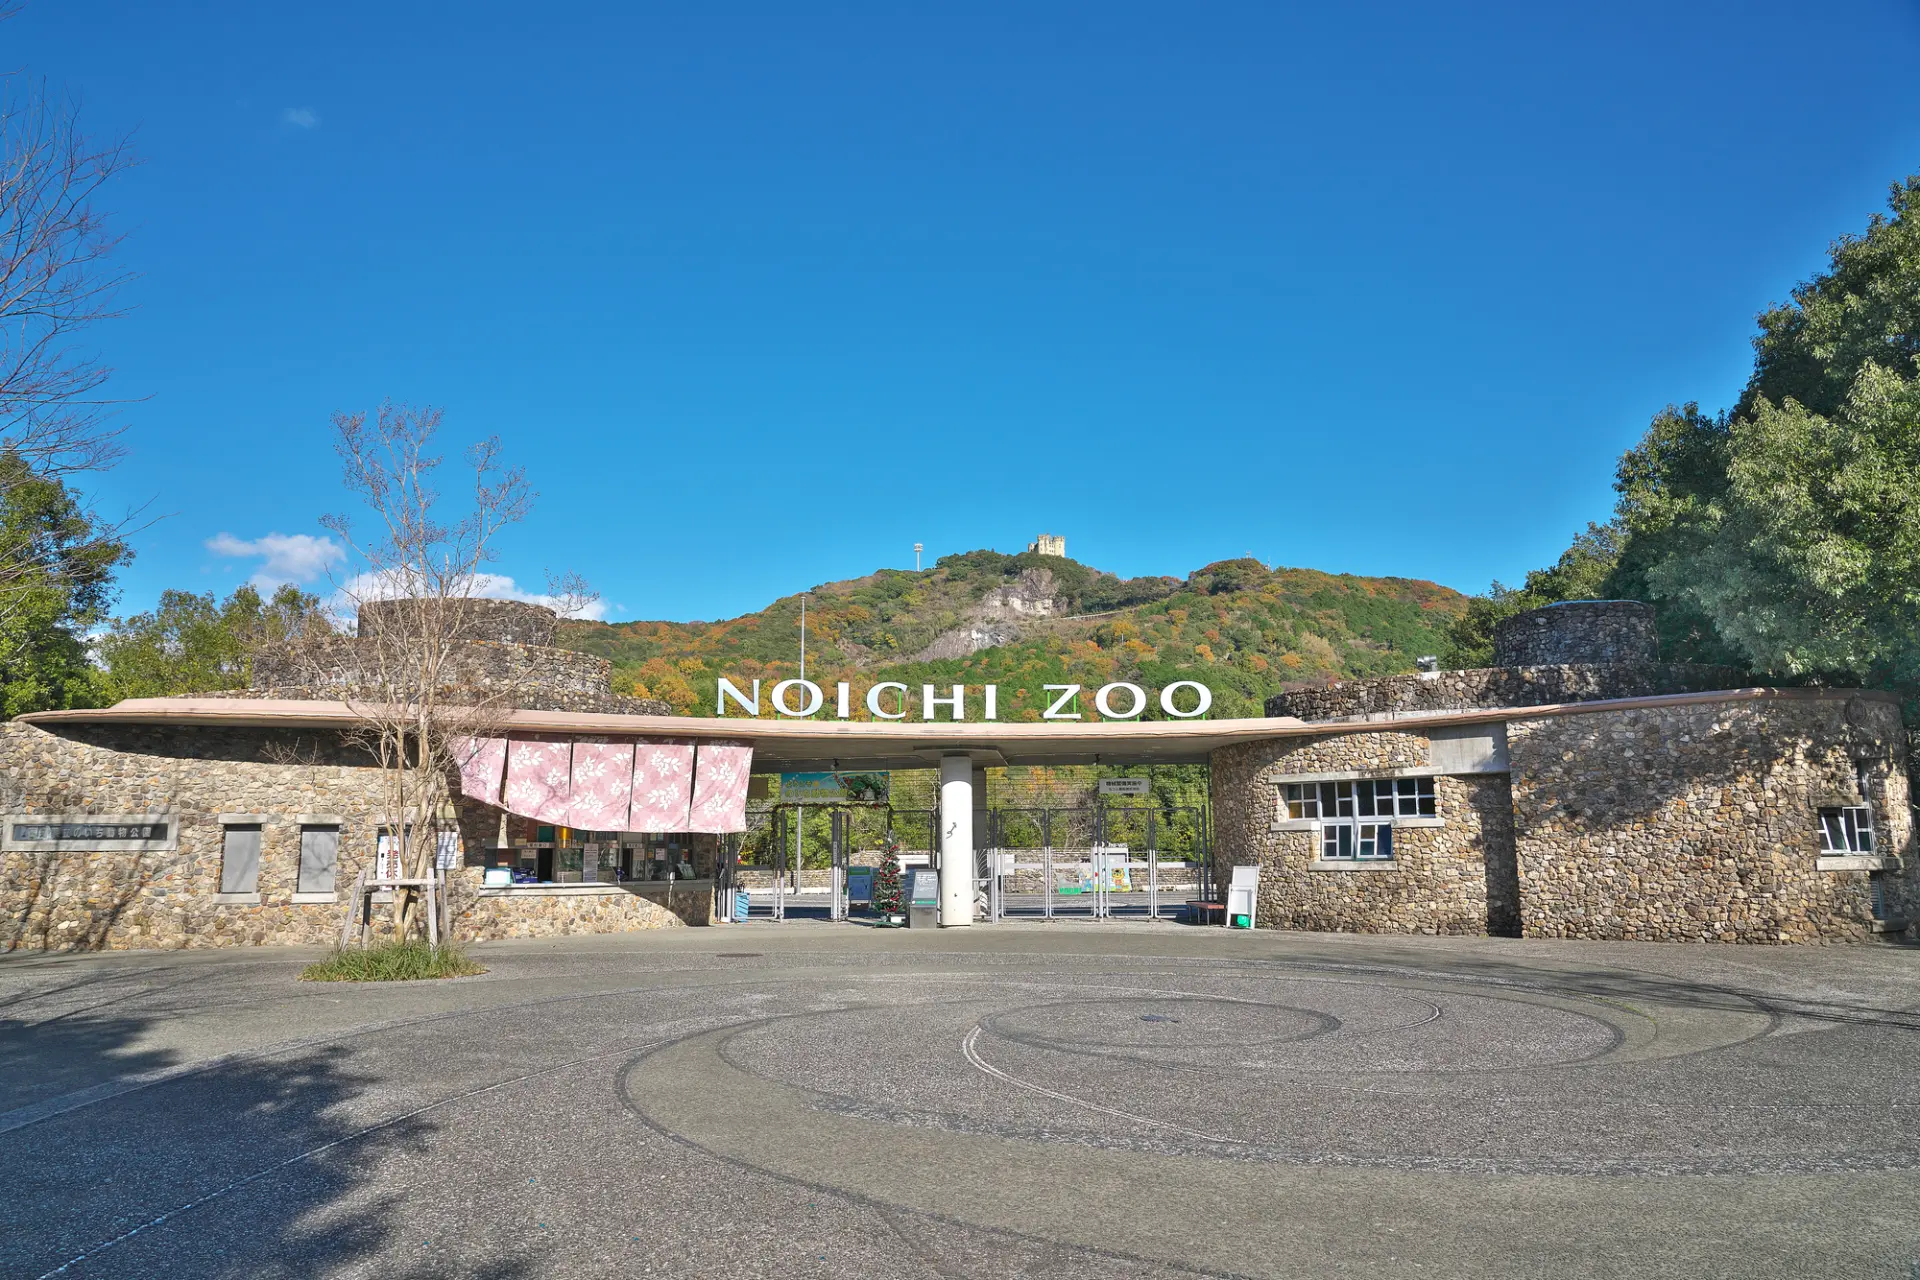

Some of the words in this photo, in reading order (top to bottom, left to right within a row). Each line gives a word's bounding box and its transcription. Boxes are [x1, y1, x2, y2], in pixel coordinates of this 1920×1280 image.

[716, 677, 997, 719] NOICHI
[1042, 680, 1213, 719] ZOO
[27, 826, 152, 839] 立のいち動物公園
